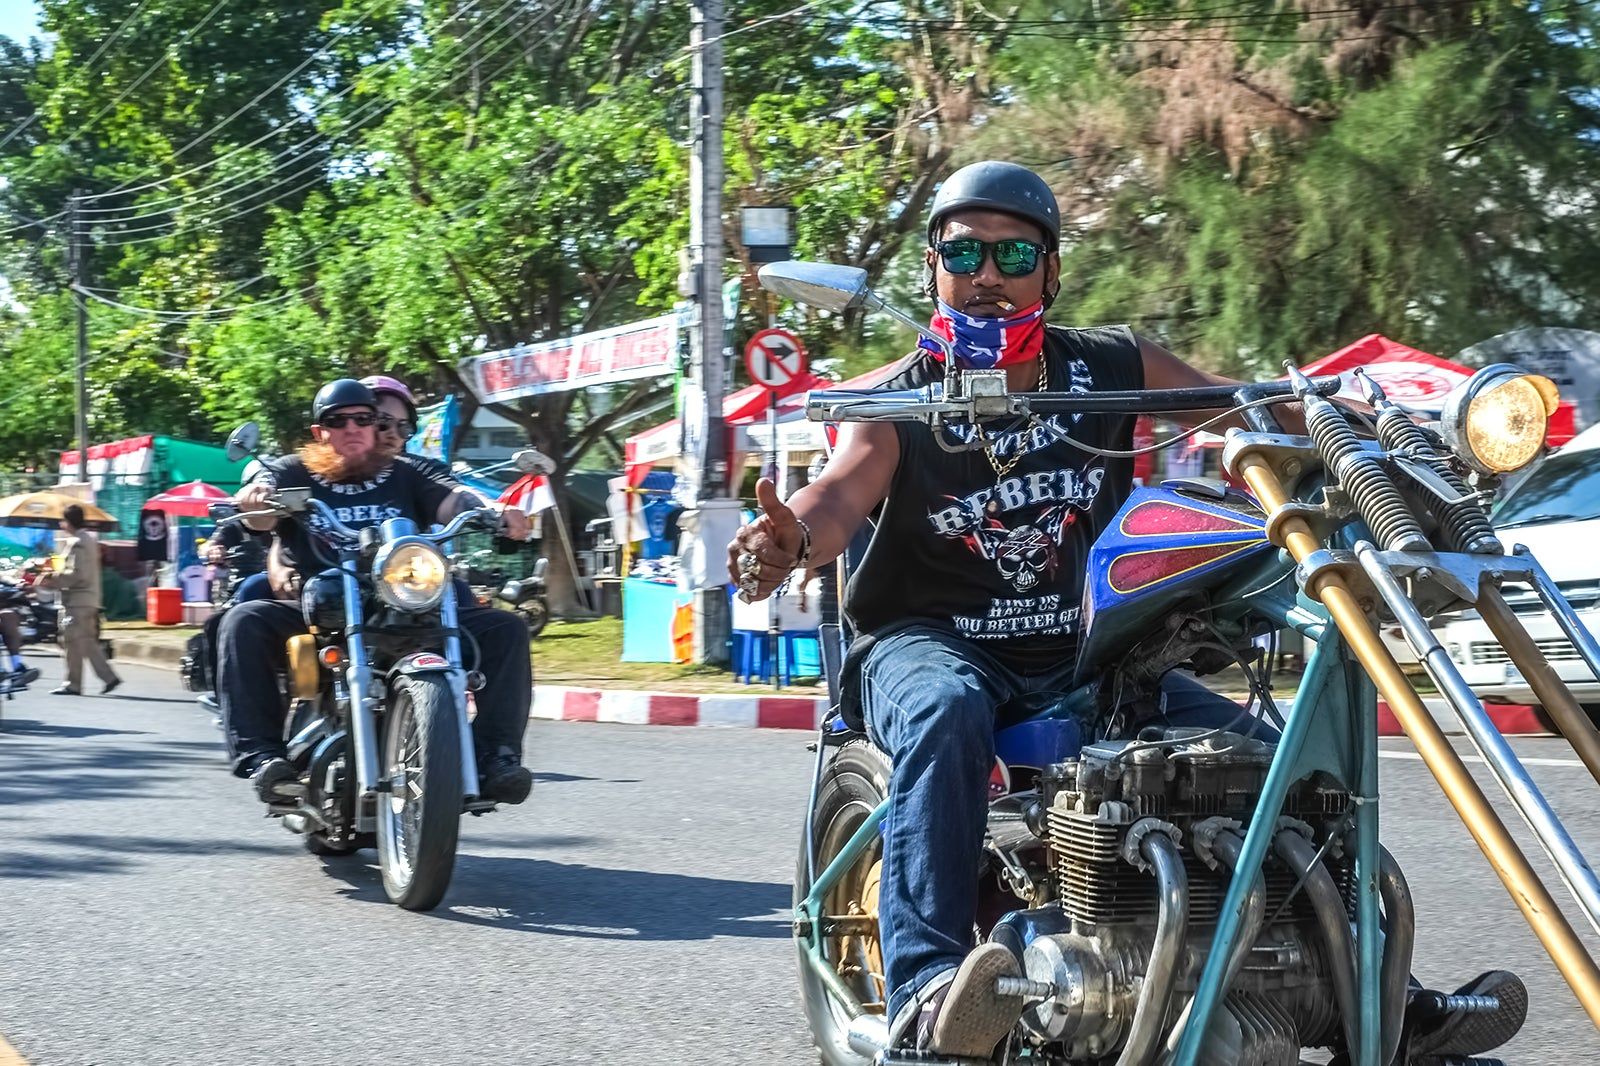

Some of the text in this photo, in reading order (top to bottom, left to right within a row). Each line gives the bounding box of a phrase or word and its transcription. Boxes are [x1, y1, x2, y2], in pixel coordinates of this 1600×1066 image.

[927, 466, 1105, 534] REBELS
[952, 607, 1081, 632] YOU BETTER GET
[988, 607, 1033, 617] HAT
